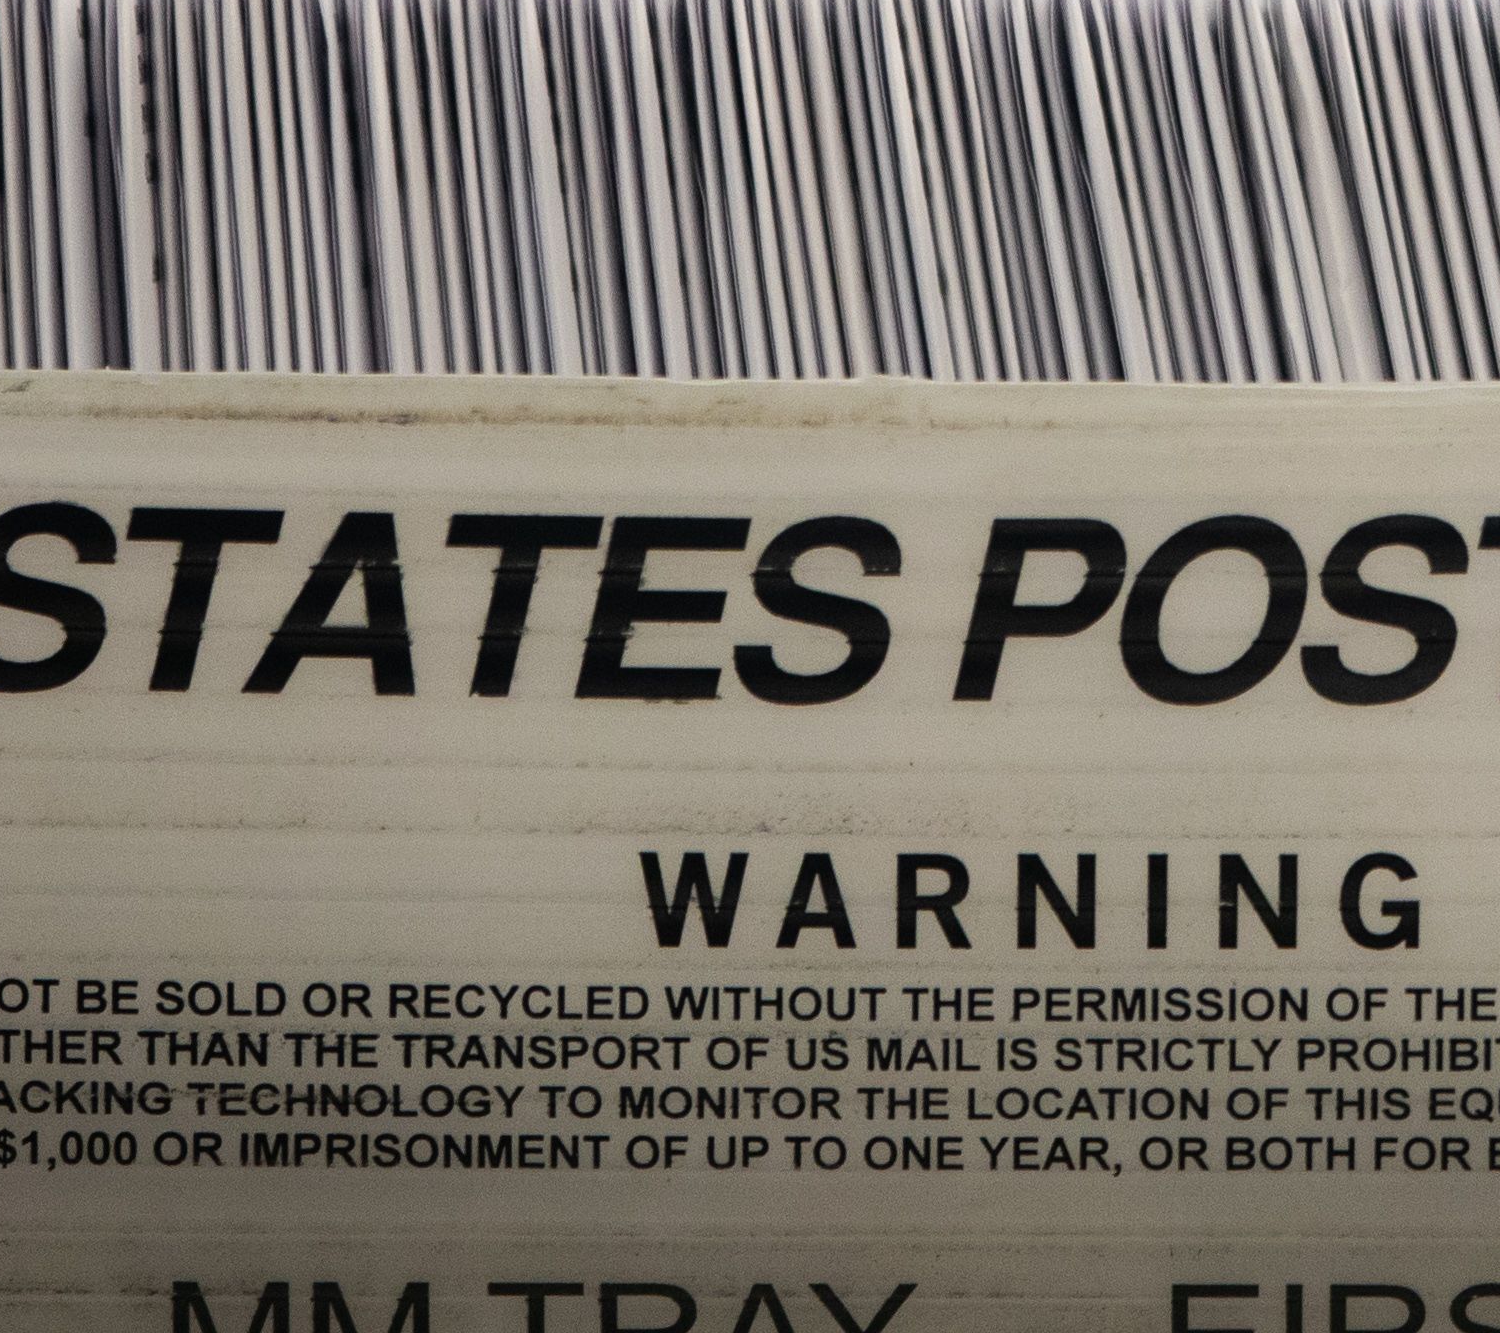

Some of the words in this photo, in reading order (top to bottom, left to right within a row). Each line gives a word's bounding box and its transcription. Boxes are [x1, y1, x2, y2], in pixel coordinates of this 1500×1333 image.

[638, 851, 1421, 951] WARNING
[76, 979, 139, 1015] BE
[155, 980, 287, 1017] SOLD
[302, 982, 372, 1018] OR
[389, 983, 649, 1020] RECYCLED
[664, 986, 887, 1022] WITHOUT
[902, 987, 995, 1022] THE
[1012, 987, 1308, 1022] PERMISSION
[1326, 987, 1388, 1022] OF
[1405, 987, 1497, 1022] THE
[137, 1030, 269, 1067] THAN
[283, 1032, 380, 1069] THE
[392, 1033, 691, 1070] TRANSPORT
[706, 1036, 770, 1071] OF
[786, 1035, 850, 1071] US
[866, 1037, 981, 1072] MAIL
[997, 1037, 1038, 1072] IS
[1054, 1037, 1282, 1072] STRICTLY
[186, 1082, 524, 1118] TECHNOLOGY
[538, 1085, 603, 1119] TO
[618, 1086, 842, 1120] MONITOR
[857, 1087, 950, 1120] THE
[967, 1087, 1209, 1121] LOCATION
[1226, 1087, 1289, 1121] OF
[1305, 1087, 1411, 1121] THIS
[151, 1130, 223, 1167] OR
[239, 1132, 610, 1169] IMPRISONMENT
[625, 1134, 689, 1170] OF
[706, 1135, 769, 1170] UP
[784, 1135, 847, 1171] TO
[863, 1135, 964, 1171] ONE
[979, 1136, 1124, 1177] YEAR,
[1139, 1136, 1209, 1171] OR
[1225, 1136, 1356, 1171] BOTH
[1374, 1136, 1472, 1171] FOR
